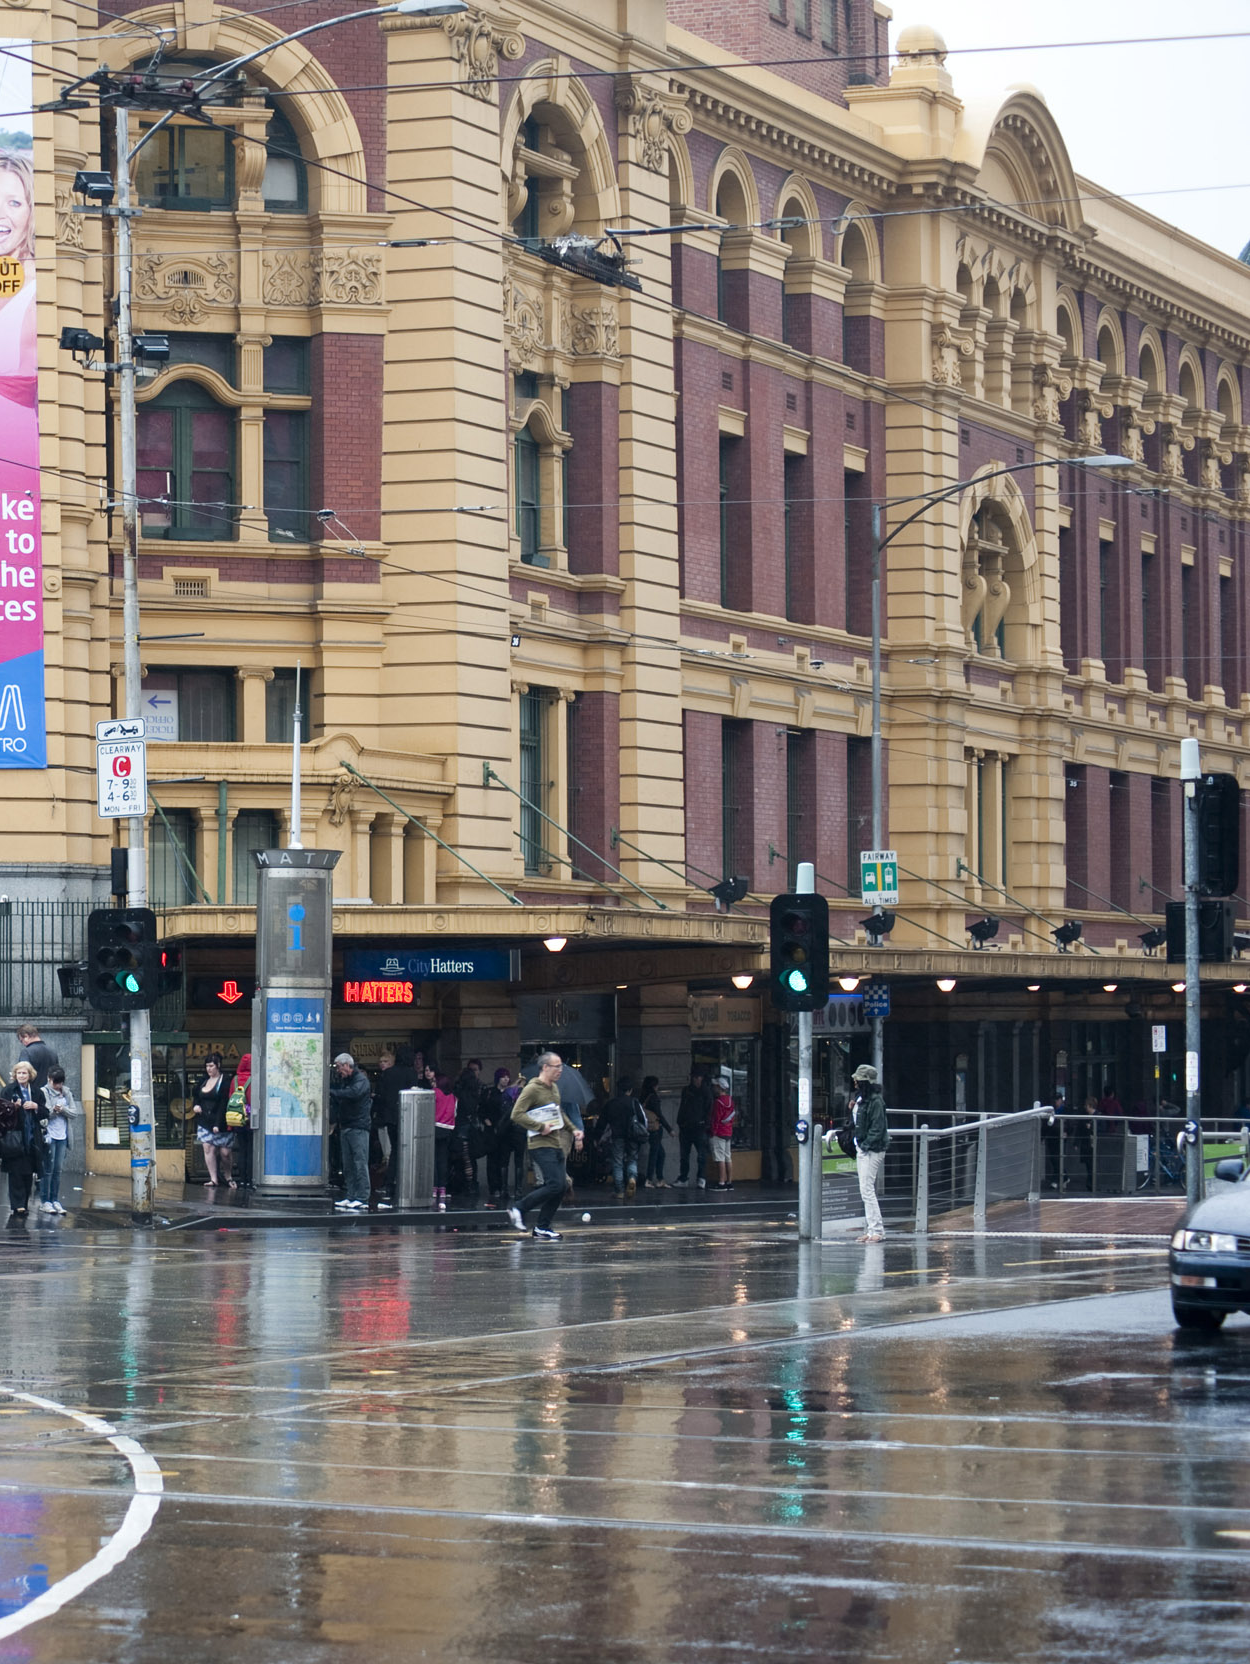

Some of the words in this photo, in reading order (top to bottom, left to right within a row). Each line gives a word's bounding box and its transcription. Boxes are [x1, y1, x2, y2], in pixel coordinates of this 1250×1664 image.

[6, 529, 34, 554] to
[100, 746, 141, 755] CLEARWAY
[116, 757, 127, 776] C
[863, 853, 894, 861] FAIRWAY
[346, 982, 413, 1003] HATTERS
